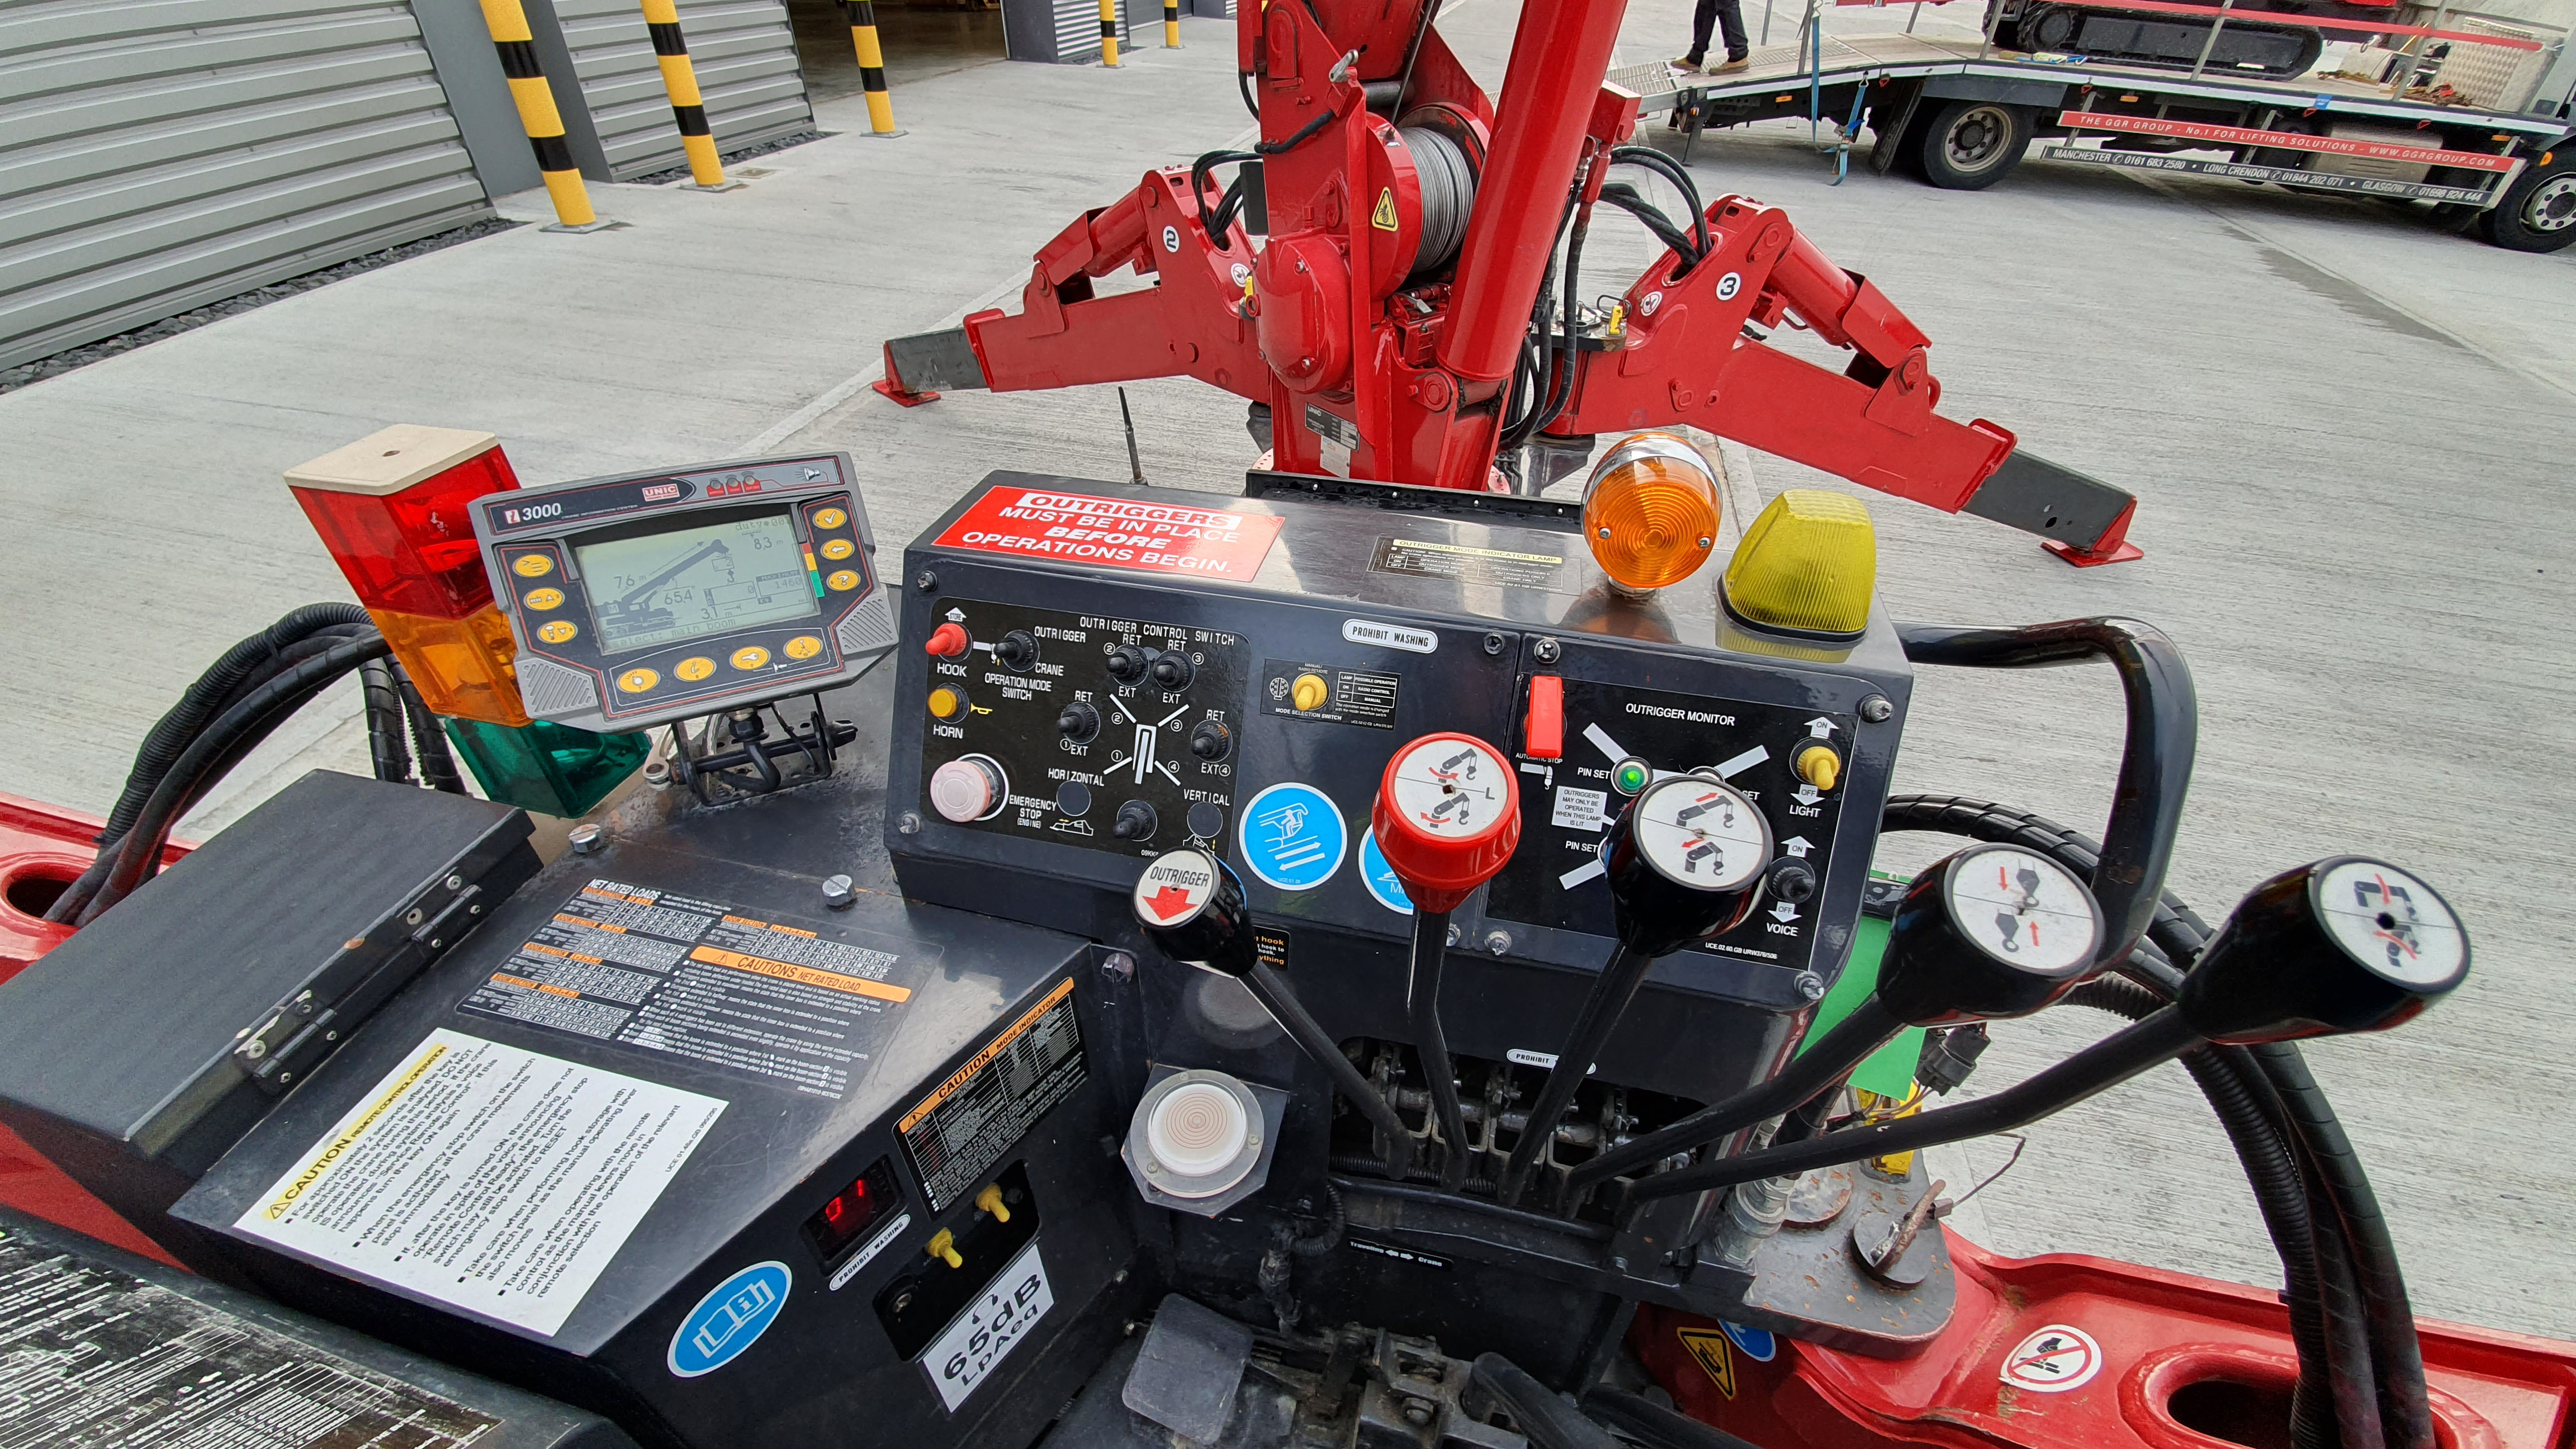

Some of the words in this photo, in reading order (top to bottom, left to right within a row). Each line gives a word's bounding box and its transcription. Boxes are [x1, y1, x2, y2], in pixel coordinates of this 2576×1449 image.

[2080, 116, 2101, 125] THE
[2105, 118, 2128, 127] GGR
[2133, 121, 2172, 131] GROUP
[2185, 126, 2209, 135] No.1
[2213, 129, 2236, 138] FOR
[2239, 132, 2285, 144] LIFTING
[2289, 137, 2355, 151] SOLUTIONS
[2369, 146, 2496, 166] WWW.GGRGROUP.COM
[2052, 148, 2111, 162] MANCHESTER
[2124, 155, 2146, 165] 0161
[2146, 158, 2163, 167] 683
[2163, 159, 2186, 169] 2580
[2203, 163, 2228, 173] LONG
[2227, 165, 2270, 178] CRENDON
[2281, 172, 2309, 182] 01844
[2308, 175, 2327, 184] 202
[2326, 177, 2344, 186] 071
[2361, 180, 2406, 193] GLASGOW
[2446, 190, 2465, 200] 824
[2465, 192, 2483, 202] 444
[1166, 230, 1176, 249] 2
[1721, 276, 1737, 297] 3
[1308, 405, 1322, 416] UNIC
[642, 484, 679, 498] UNIC
[522, 503, 562, 520] 3000
[1026, 495, 1232, 527] OUTRIGGERS
[998, 506, 1074, 523] MUST
[1076, 515, 1114, 528] BE
[1117, 519, 1147, 532] IN
[1150, 523, 1242, 543] PLACE
[1042, 525, 1173, 550] BEFORE
[962, 532, 1134, 560] OPERATIONS
[1138, 551, 1237, 572] BEGIN.
[1399, 541, 1451, 550] OUTRIGGER
[1481, 550, 1530, 559] INDICATOR
[669, 624, 701, 638] main
[705, 617, 736, 631] boom
[1034, 626, 1086, 642] OUTRIGGER
[1079, 616, 1137, 633] OUTRIGGER
[1143, 624, 1187, 640] CONTROL
[1195, 630, 1234, 646] SWITCH
[1122, 633, 1142, 645] RET
[1167, 639, 1186, 651] RET
[1352, 626, 1388, 640] PROHIBIT
[1394, 632, 1428, 647] WASHING
[936, 662, 967, 677] HOOK
[1034, 661, 1064, 676] CRANE
[984, 673, 1027, 688] OPERATION
[1029, 678, 1052, 692] MODE
[1002, 686, 1031, 700] SWITCH
[1074, 690, 1092, 702] RET
[1118, 685, 1136, 698] EXT
[1162, 692, 1181, 704] EXT
[1206, 709, 1225, 721] RET
[1291, 709, 1320, 718] SELECTION
[1626, 703, 1685, 719] OUTRIGGER
[1687, 711, 1735, 726] MONITOR
[933, 724, 963, 738] HORN
[1070, 744, 1088, 756] EXT
[1048, 768, 1104, 786] HORIZONTAL
[1201, 763, 1219, 775] EXT
[1577, 766, 1592, 776] PIN
[1593, 769, 1611, 779] SET
[1008, 794, 1057, 811] EMERGENCY
[1183, 788, 1229, 806] VERTICAL
[1564, 789, 1599, 799] OUTRIGGERS
[1019, 807, 1041, 819] STOP
[1564, 804, 1594, 813] OPERATED
[1789, 804, 1821, 817] LIGHT
[1017, 817, 1041, 829] (ENGINE)
[1565, 840, 1580, 850] PIN
[1581, 842, 1599, 853] SET
[1149, 866, 1210, 887] OUTRIGGER
[587, 878, 608, 889] NET
[603, 882, 634, 894] RATED
[629, 887, 661, 900] LOADS
[1775, 904, 1792, 913] OFF
[1766, 922, 1798, 936] VOICE
[1261, 935, 1284, 945] hook
[1257, 946, 1275, 955] hook.
[1259, 955, 1285, 965] ything
[737, 956, 798, 977] CAUTIONS
[797, 971, 816, 981] NET
[812, 974, 840, 986] RATED
[837, 979, 861, 991] LOAD
[936, 1050, 992, 1098] CAUTION
[996, 1028, 1017, 1050] MODE
[1019, 996, 1057, 1031] INDICATOR
[1516, 1053, 1549, 1063] PROHIBIT
[285, 1138, 351, 1199] CAUTION
[351, 1110, 382, 1137] REMOTE
[378, 1080, 413, 1110] CONTROL
[409, 1046, 447, 1080] OPERATION
[291, 1201, 309, 1216] For
[309, 1143, 367, 1200] approximately
[372, 1103, 408, 1135] seconds
[407, 1085, 425, 1102] after
[423, 1072, 438, 1084] the
[435, 1059, 452, 1072] key
[443, 1216, 490, 1267] emergency
[488, 1195, 508, 1214] stop
[506, 1166, 533, 1194] switch
[531, 1156, 542, 1164] to
[538, 1125, 567, 1154] RESET
[381, 1226, 401, 1246] stop
[399, 1173, 450, 1224] immediately
[486, 1261, 505, 1281] also
[504, 1228, 533, 1259] moves
[537, 1263, 567, 1298] remote
[565, 1220, 601, 1262] selection
[839, 1251, 869, 1282] PROHIBIT
[874, 1221, 903, 1249] WASHING
[944, 1273, 1040, 1380] 65dB
[961, 1303, 1038, 1386] LpAeq
